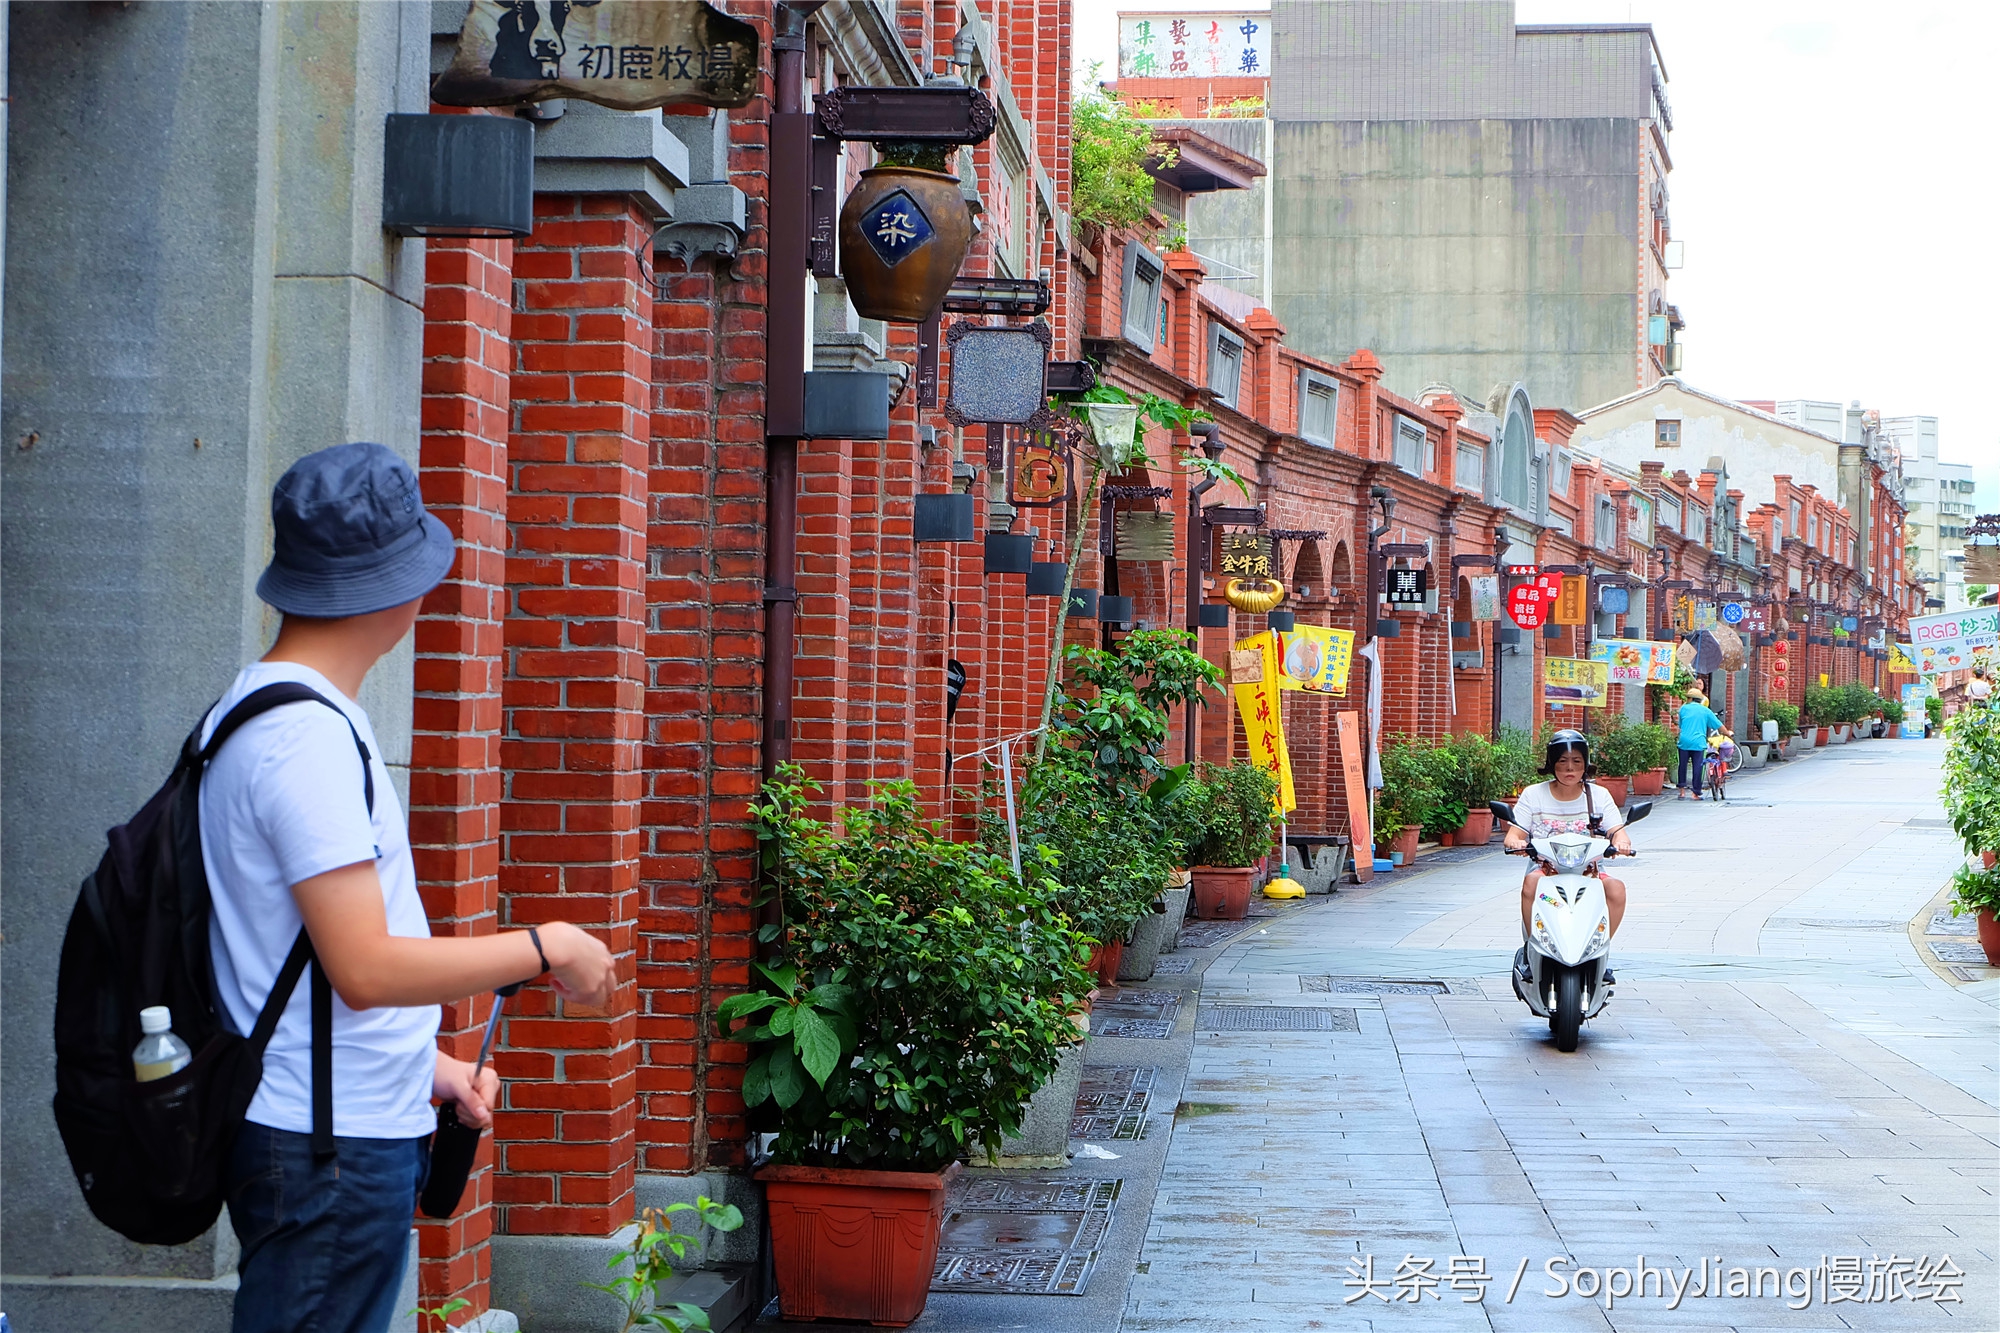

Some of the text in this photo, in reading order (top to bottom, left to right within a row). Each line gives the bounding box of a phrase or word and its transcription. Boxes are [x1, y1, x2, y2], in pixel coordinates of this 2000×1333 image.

[577, 43, 735, 81] 初鹿牧場
[1133, 19, 1157, 75] 集郵
[1168, 18, 1191, 73] 藝品
[1238, 19, 1261, 74] 中藥
[877, 212, 917, 247] 染
[1219, 553, 1269, 576] 金牛角
[1917, 621, 1959, 641] RGB
[1654, 648, 1672, 681] 澎湖
